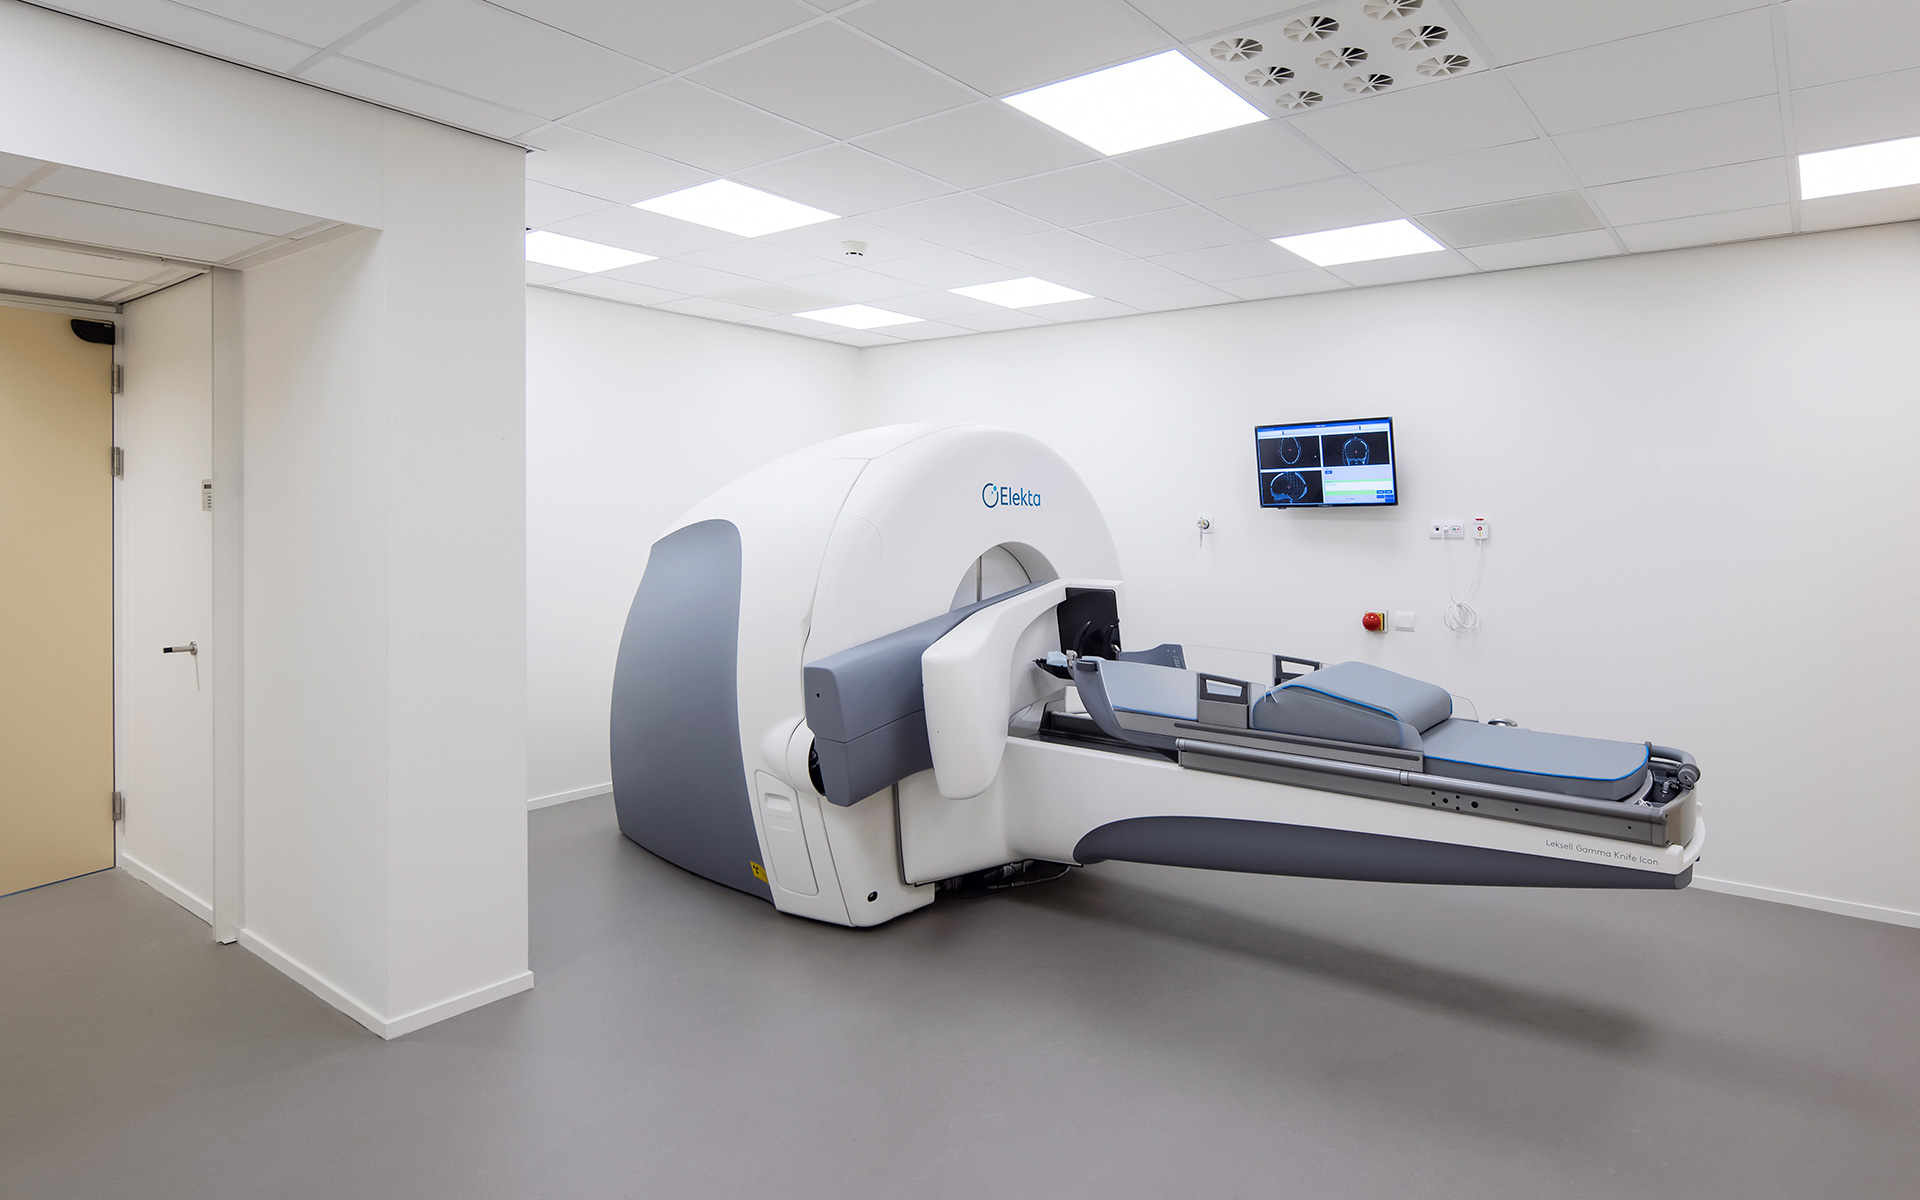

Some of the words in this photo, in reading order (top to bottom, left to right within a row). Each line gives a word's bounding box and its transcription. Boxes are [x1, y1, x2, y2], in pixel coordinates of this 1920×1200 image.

[1000, 486, 1041, 507] Elekta
[1546, 839, 1573, 850] Leksell
[1576, 845, 1611, 857] Gamma
[1614, 851, 1637, 862] Knife
[1639, 856, 1659, 866] Icon
